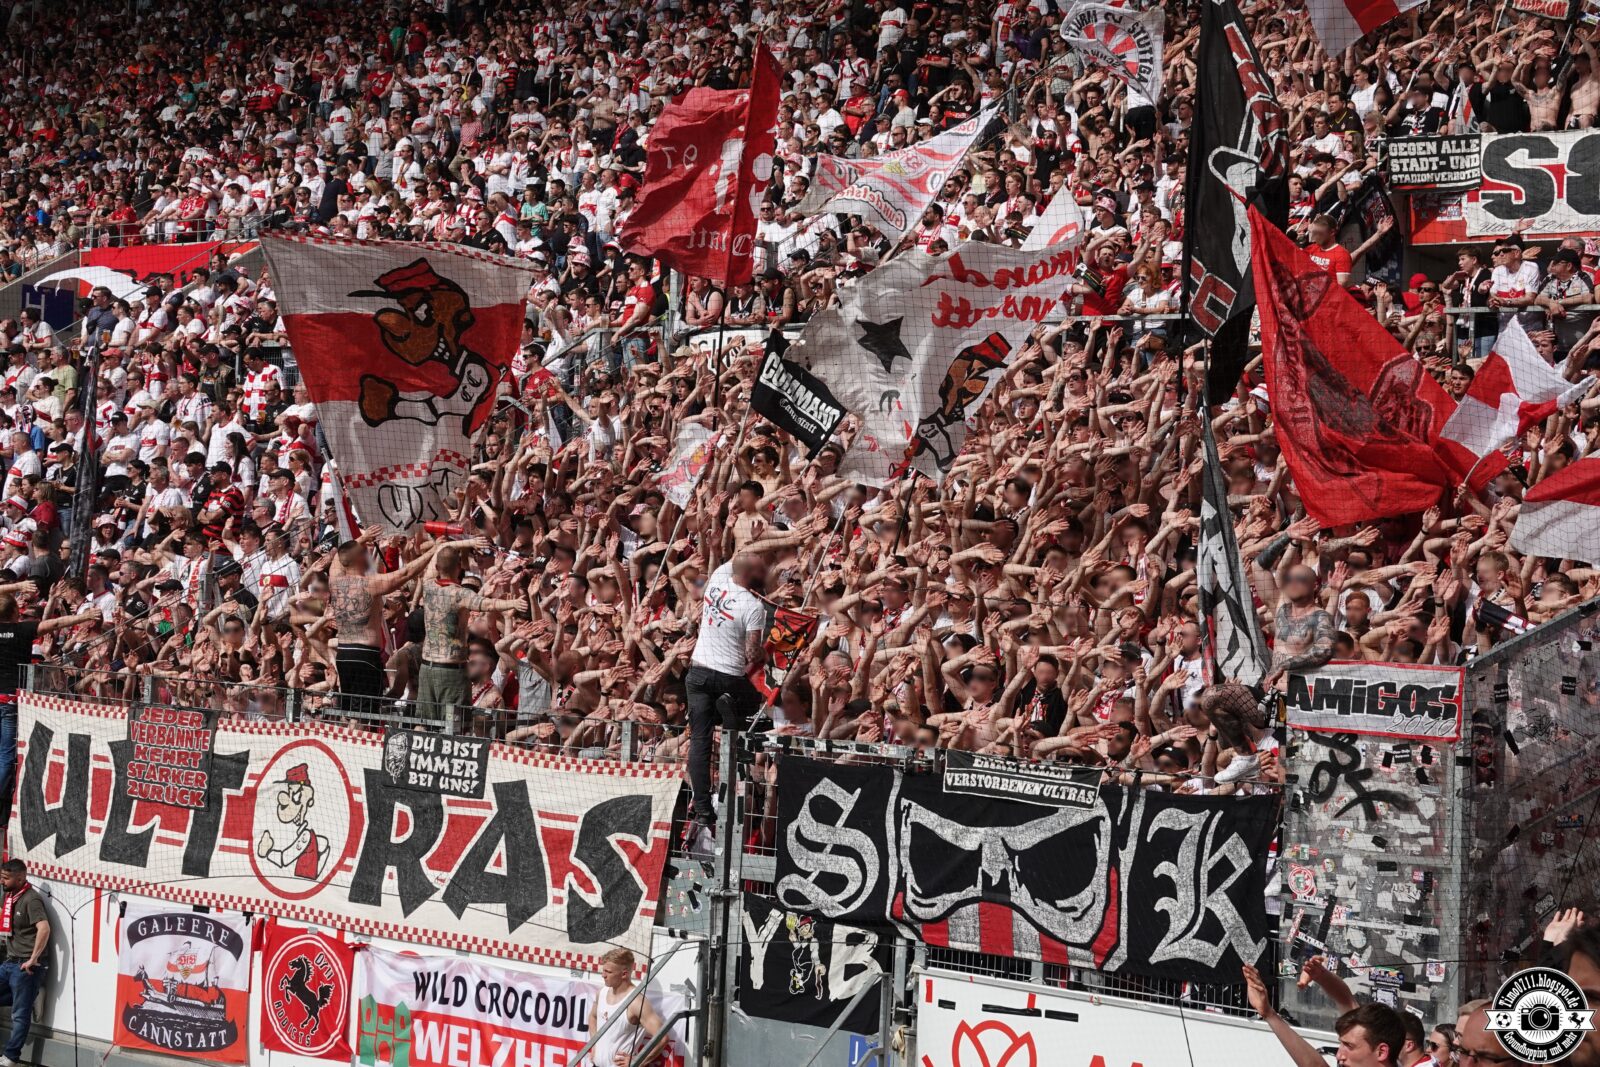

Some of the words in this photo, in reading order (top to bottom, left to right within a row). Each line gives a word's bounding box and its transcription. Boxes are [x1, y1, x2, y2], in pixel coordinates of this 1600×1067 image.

[1388, 141, 1437, 157] GEGEN
[1441, 138, 1480, 154] ALLE
[1390, 156, 1446, 173] STADT-
[1449, 153, 1480, 170] UND
[140, 706, 204, 729] JEDER
[1385, 714, 1458, 737] 2010
[129, 720, 212, 751] VERBANNTE
[411, 735, 436, 753] DU
[441, 739, 482, 758] BIST
[134, 744, 203, 769] KEHRT
[410, 752, 479, 779] IMMER
[408, 771, 434, 788] BEI
[439, 775, 480, 794] UNS!
[946, 772, 1044, 796] VERSTORBENEN
[1042, 784, 1096, 805] ULTRAS
[776, 777, 880, 918] S
[137, 916, 230, 948] GALEERE
[742, 907, 783, 990] Y
[829, 922, 883, 1001] B
[412, 970, 468, 1008] WILD
[474, 980, 590, 1033] CROCODIL
[128, 1014, 228, 1049] CANNSTATT
